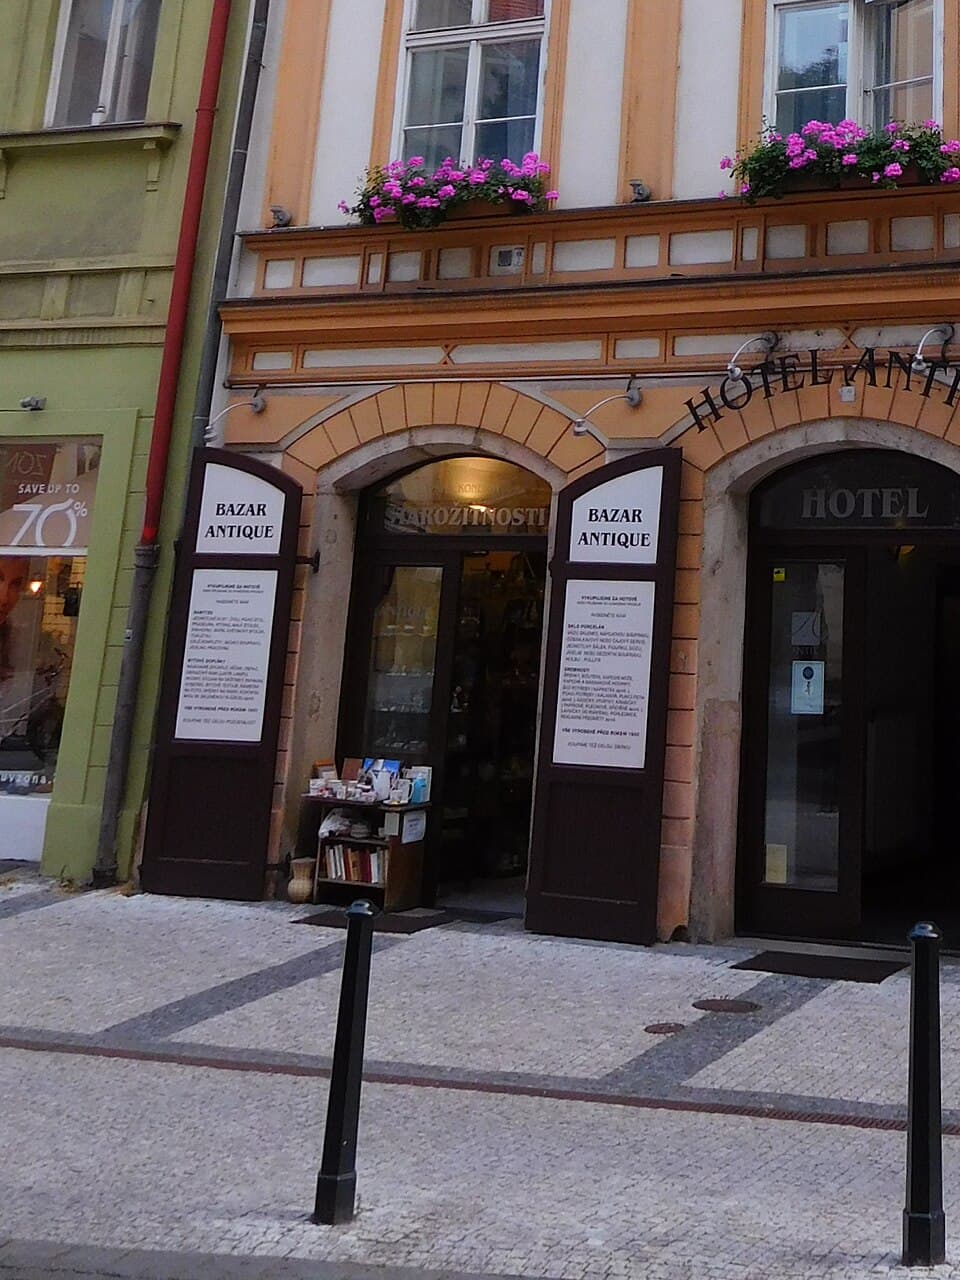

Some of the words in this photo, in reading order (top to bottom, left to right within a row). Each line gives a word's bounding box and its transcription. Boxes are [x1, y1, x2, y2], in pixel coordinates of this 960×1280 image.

[684, 348, 834, 434] HOTEL
[18, 483, 47, 494] SAVE
[47, 483, 61, 493] UP
[65, 483, 80, 493] TO
[215, 503, 267, 517] BAZAR
[800, 487, 929, 519] HOTEL
[588, 508, 643, 523] BAZAR
[204, 525, 274, 540] ANTIQUE
[577, 531, 651, 549] ANTIQUE
